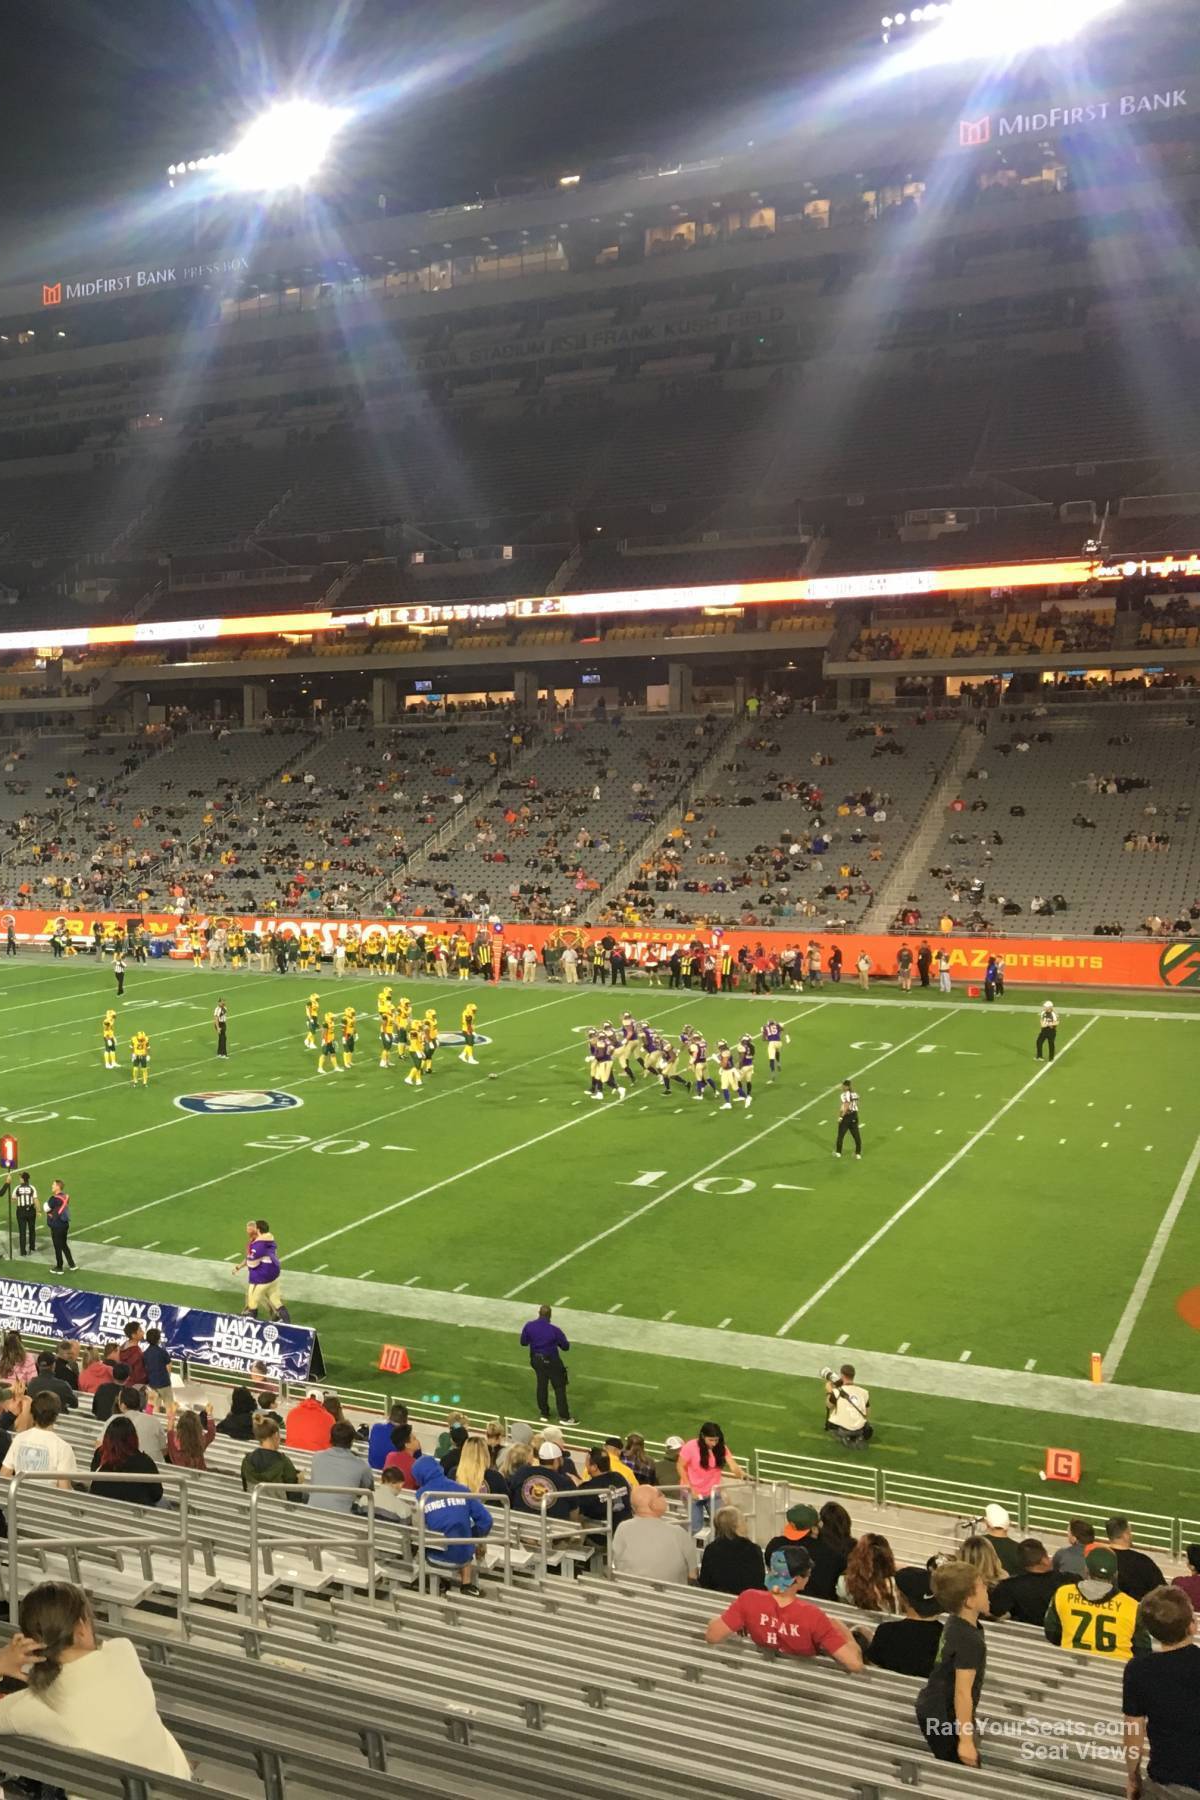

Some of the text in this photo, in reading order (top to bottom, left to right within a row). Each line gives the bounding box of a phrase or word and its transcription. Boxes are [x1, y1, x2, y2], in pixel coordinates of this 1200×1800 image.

[1119, 89, 1187, 115] BANK
[137, 268, 177, 287] BANK
[183, 264, 220, 280] PRESS
[224, 257, 249, 272] BOX
[592, 324, 657, 347] FRANK
[620, 931, 698, 941] ARIZONA
[4, 1140, 13, 1161] 1
[244, 1135, 371, 1155] 20
[615, 1170, 757, 1195] 10
[103, 1298, 147, 1319] NAVY
[23, 1319, 53, 1336] Union
[215, 1317, 262, 1339] NAVY
[212, 1333, 280, 1358] FEDERAL
[210, 1352, 244, 1371] Credit
[384, 1348, 401, 1369] 10
[1053, 1453, 1072, 1478] G
[1071, 1609, 1117, 1652] 76
